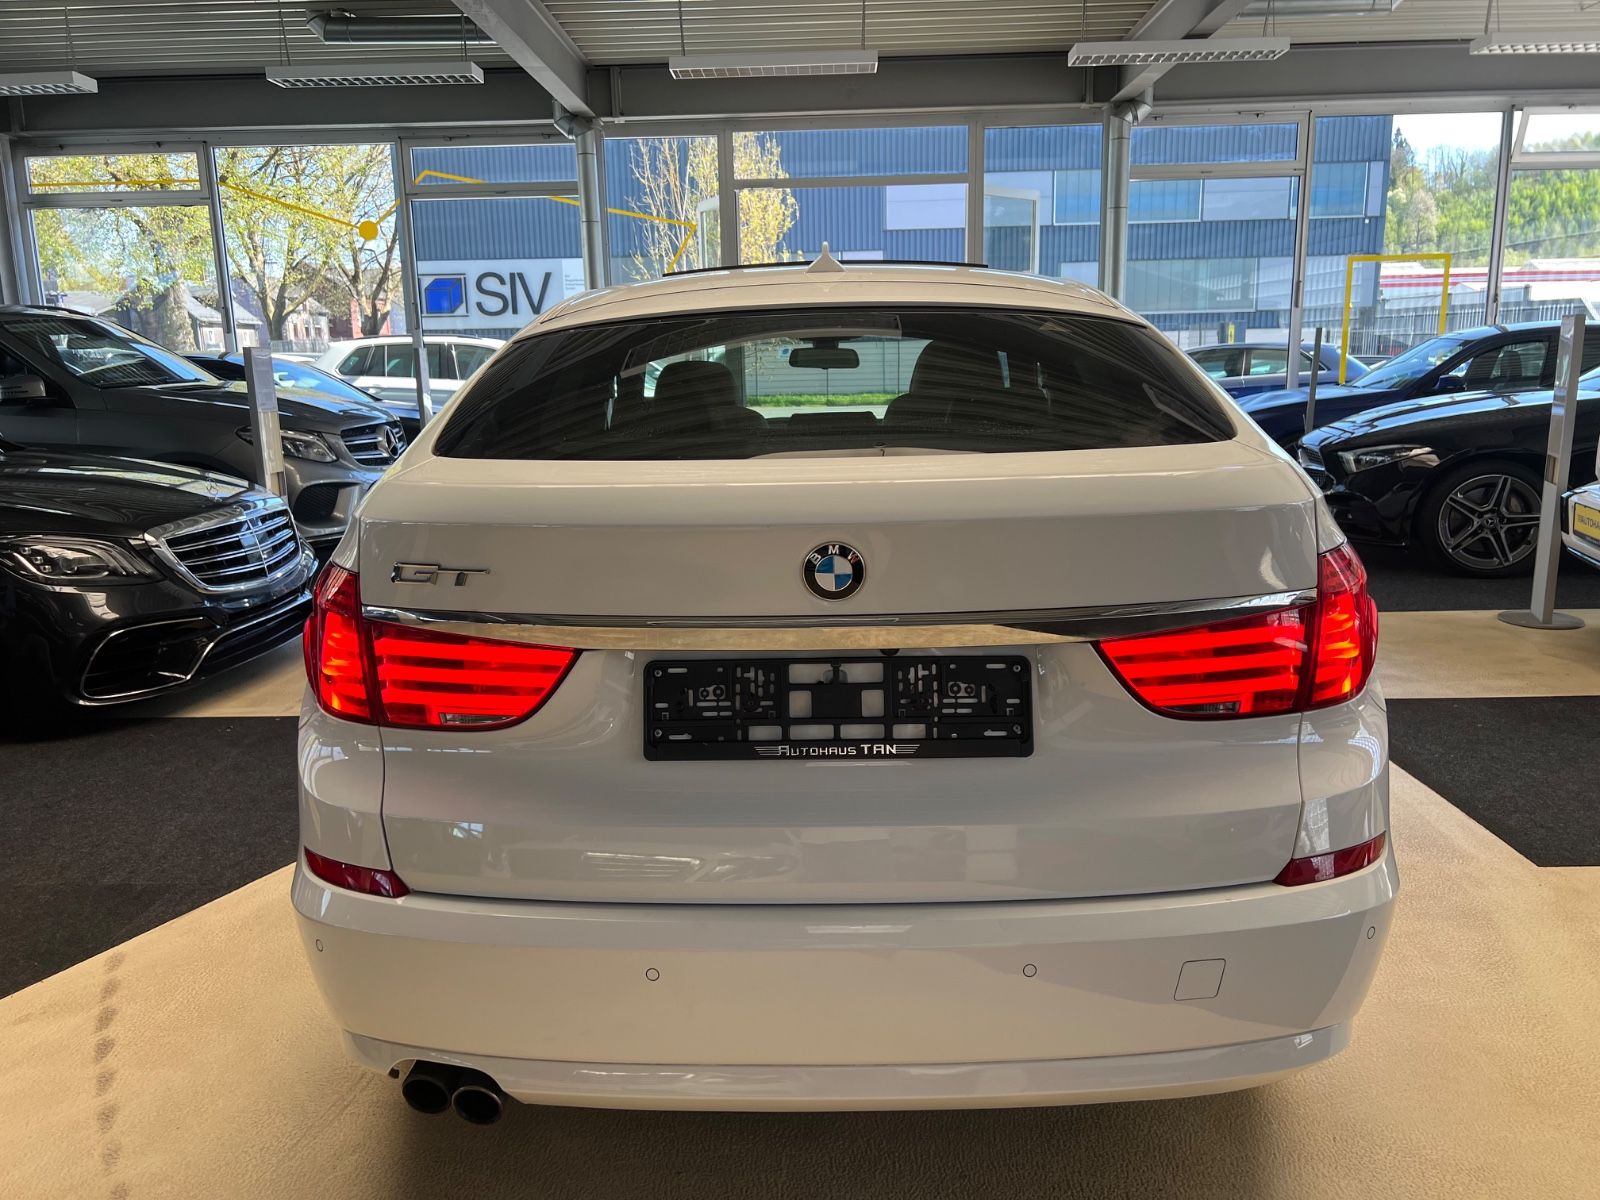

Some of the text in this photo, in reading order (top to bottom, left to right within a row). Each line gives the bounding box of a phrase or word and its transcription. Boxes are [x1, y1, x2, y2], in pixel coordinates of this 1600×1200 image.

[475, 271, 552, 317] SIV
[809, 544, 860, 565] BMW
[390, 561, 490, 587] GT
[860, 743, 897, 755] TAN
